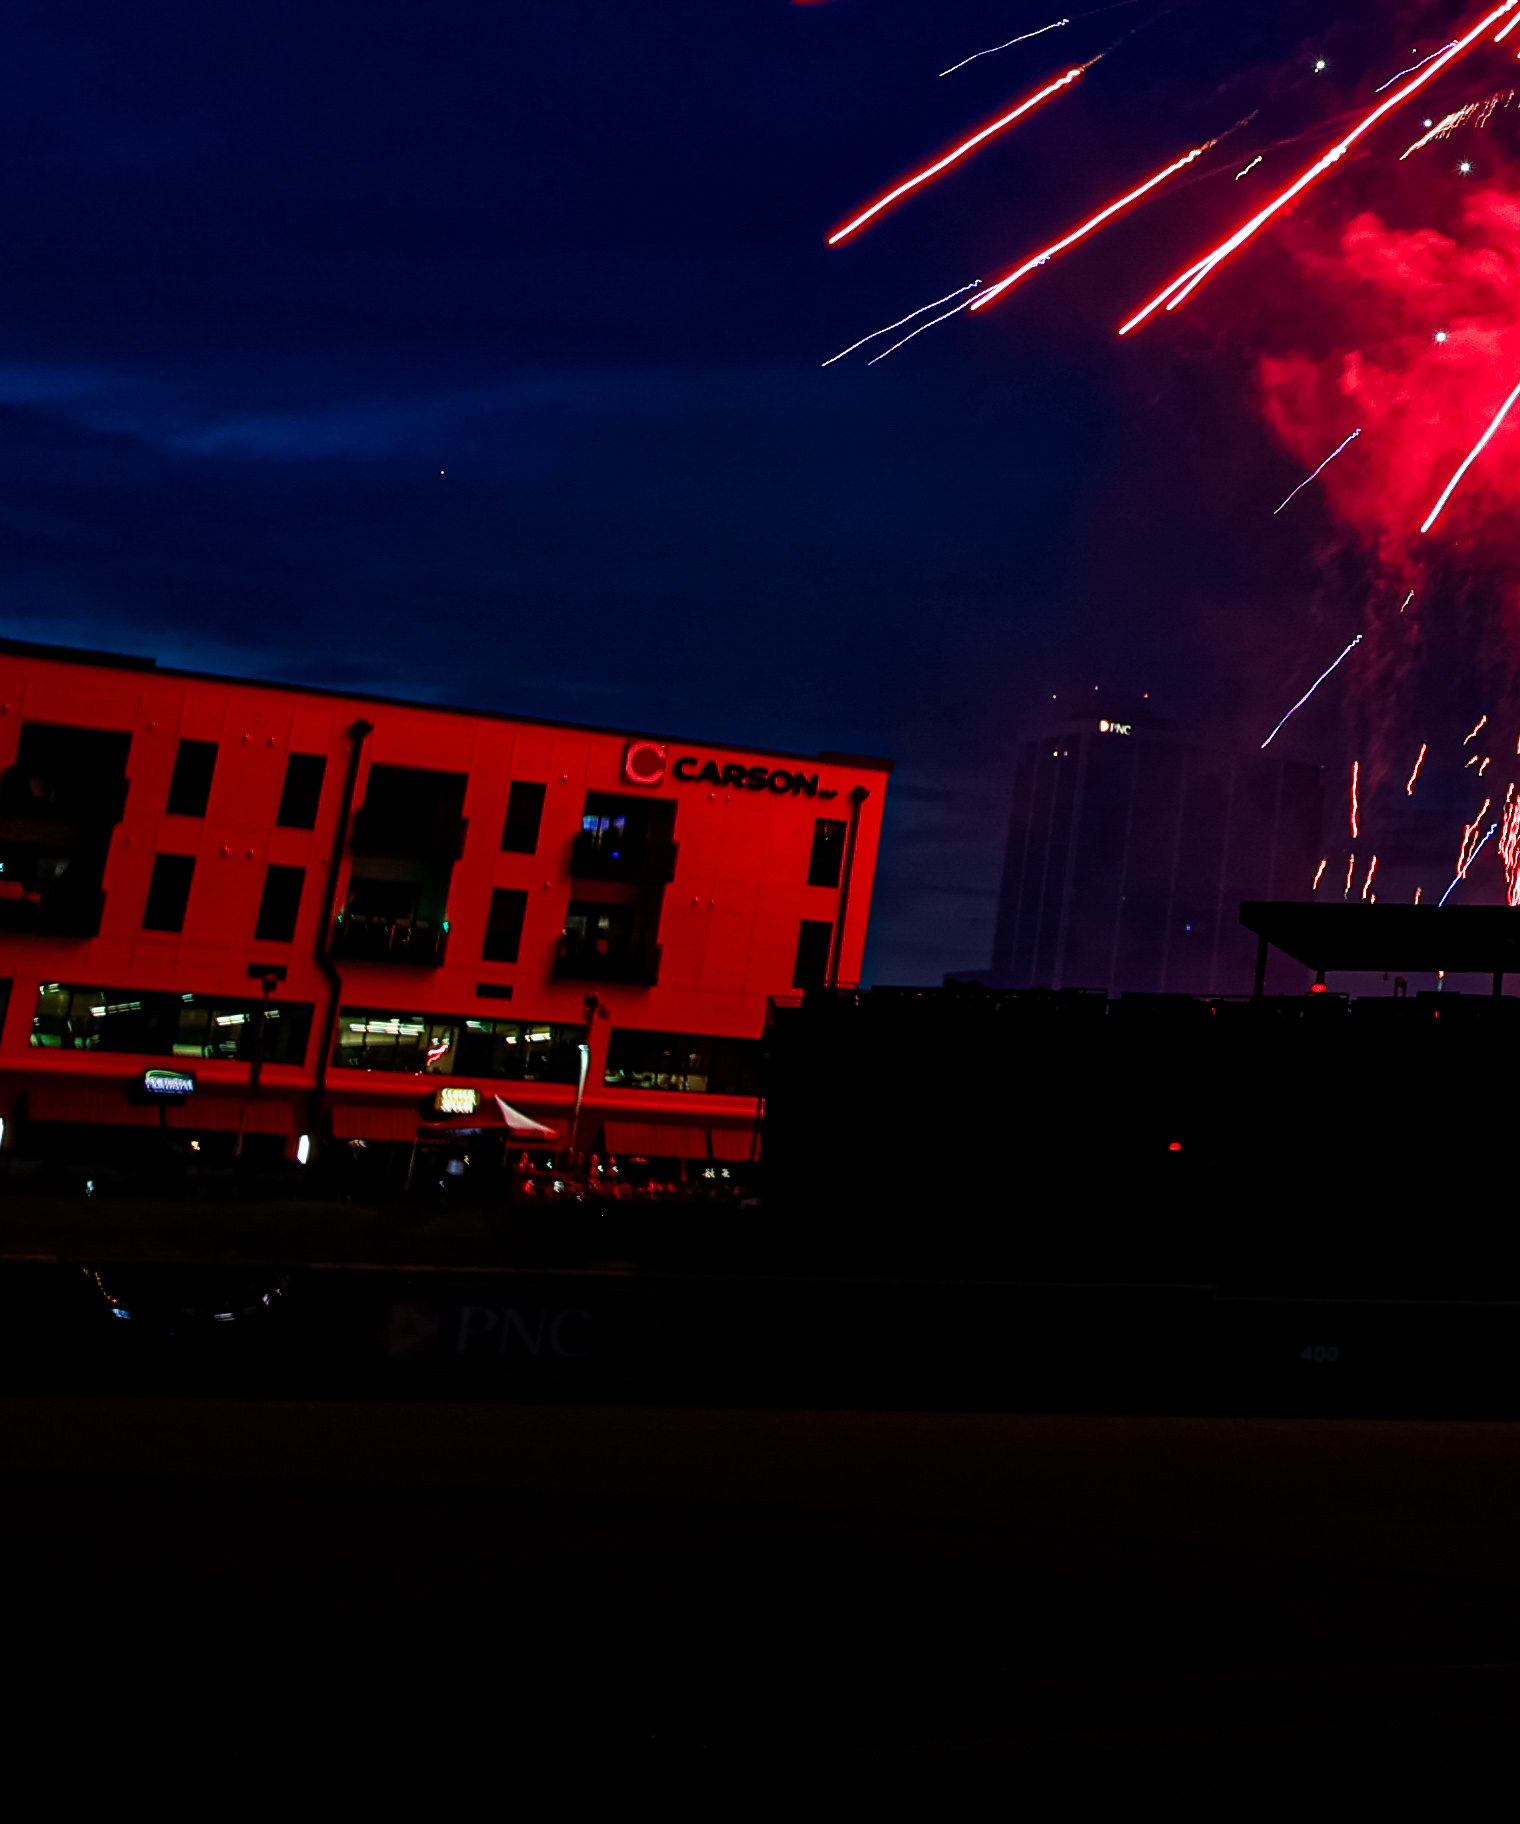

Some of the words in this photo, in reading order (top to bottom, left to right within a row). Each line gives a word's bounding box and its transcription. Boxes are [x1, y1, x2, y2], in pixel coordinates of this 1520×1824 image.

[673, 757, 819, 796] CARSON
[455, 1304, 594, 1357] PNC
[1300, 1345, 1341, 1363] 400
